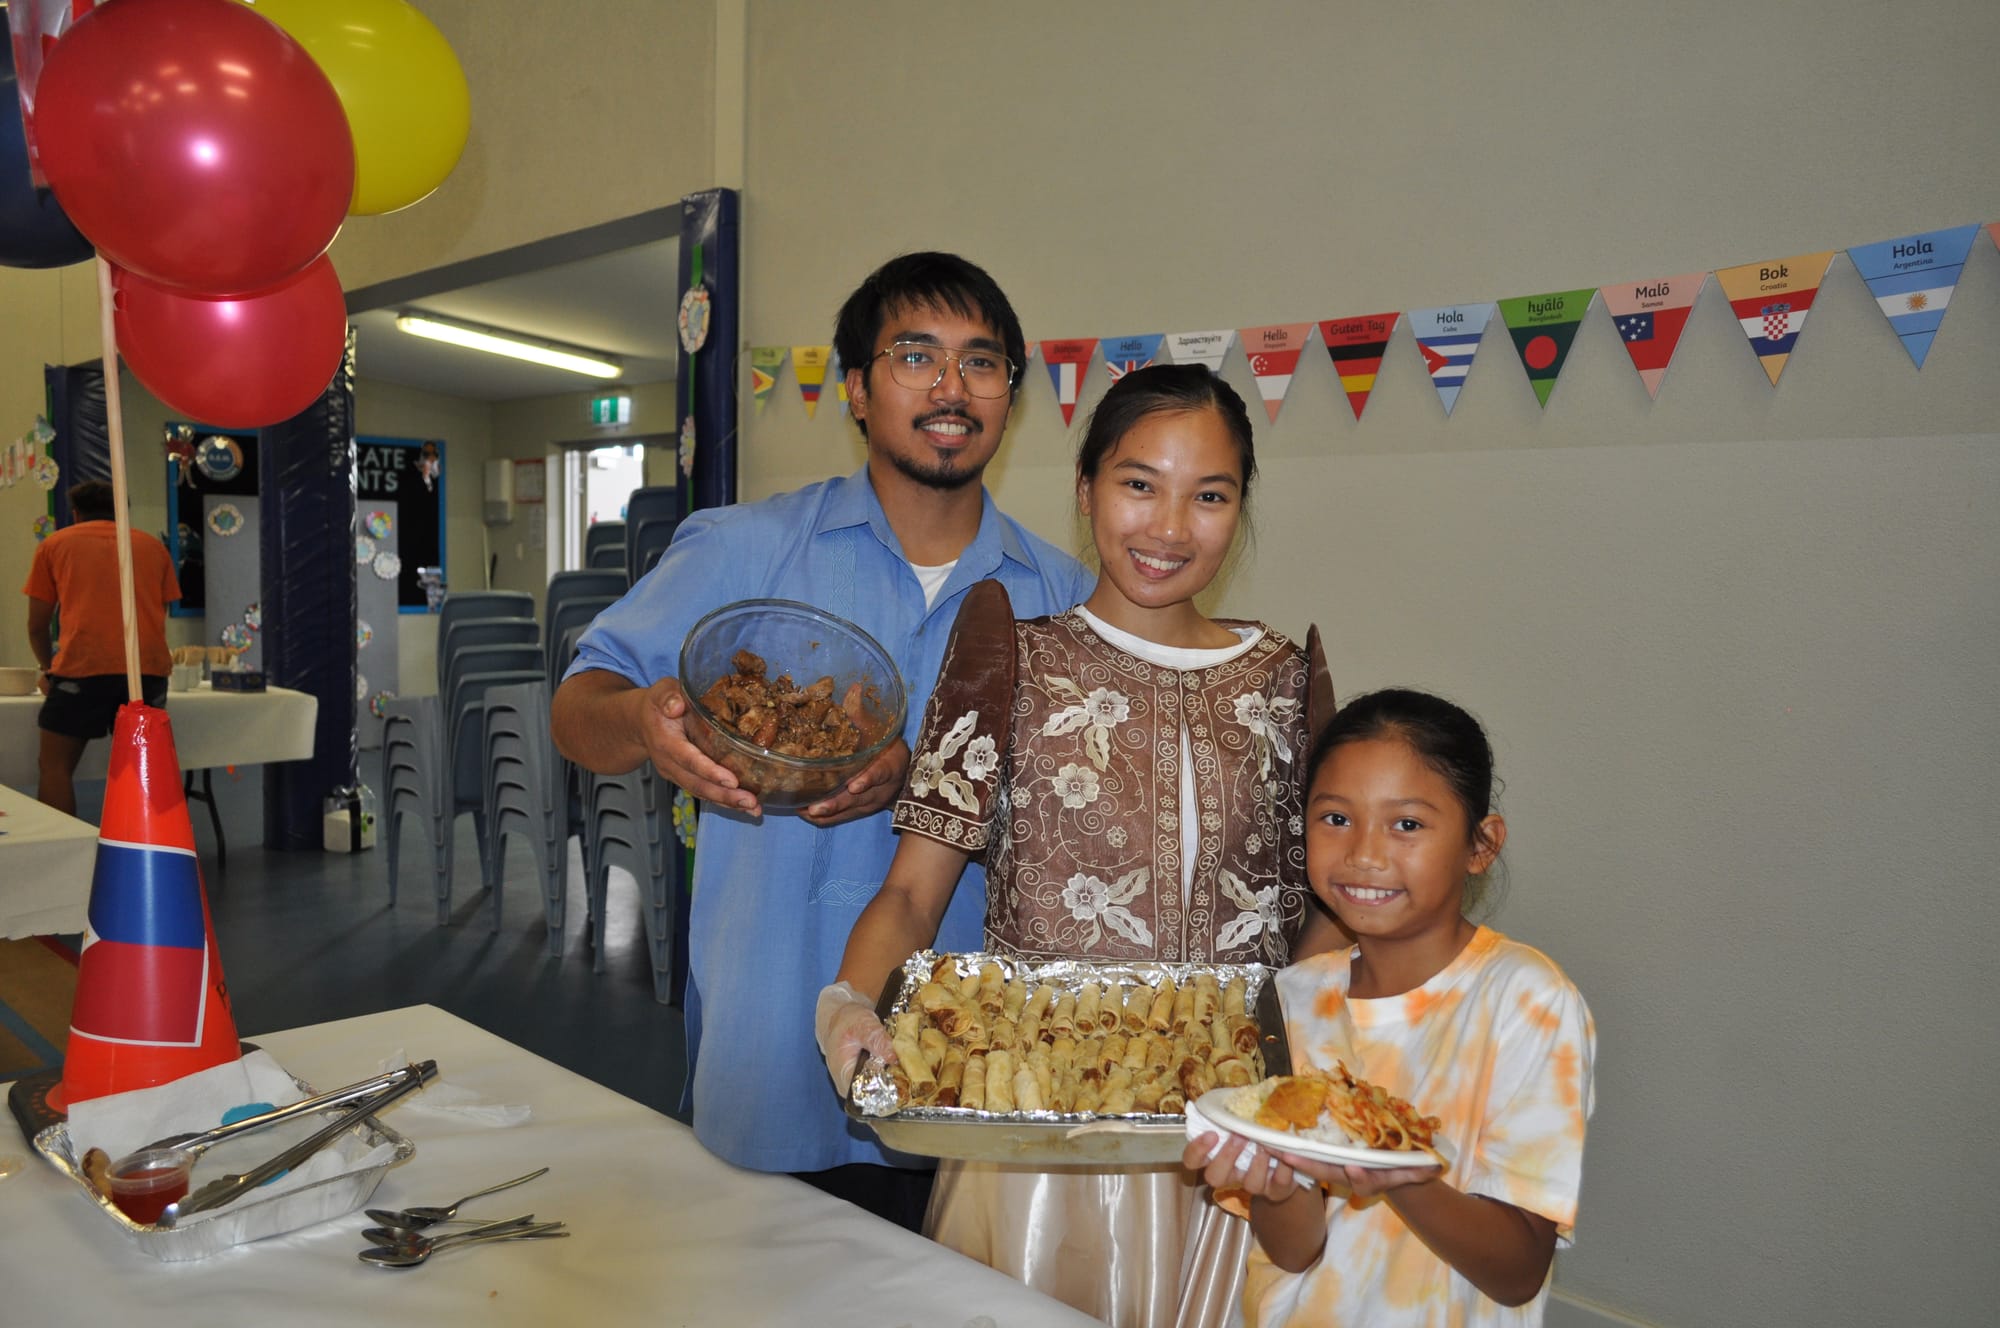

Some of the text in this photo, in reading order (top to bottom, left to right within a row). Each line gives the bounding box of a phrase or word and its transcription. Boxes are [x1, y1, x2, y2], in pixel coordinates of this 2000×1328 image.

[1892, 239, 1934, 259] Hola
[1893, 258, 1934, 271] Argentina
[1759, 264, 1789, 281] Bok
[1635, 282, 1670, 300] Malō
[1760, 282, 1788, 292] Croatia
[1436, 310, 1464, 324] Hola
[1263, 328, 1288, 341] Hello
[1330, 319, 1386, 336] Guten Tag
[1119, 339, 1143, 351] Hello
